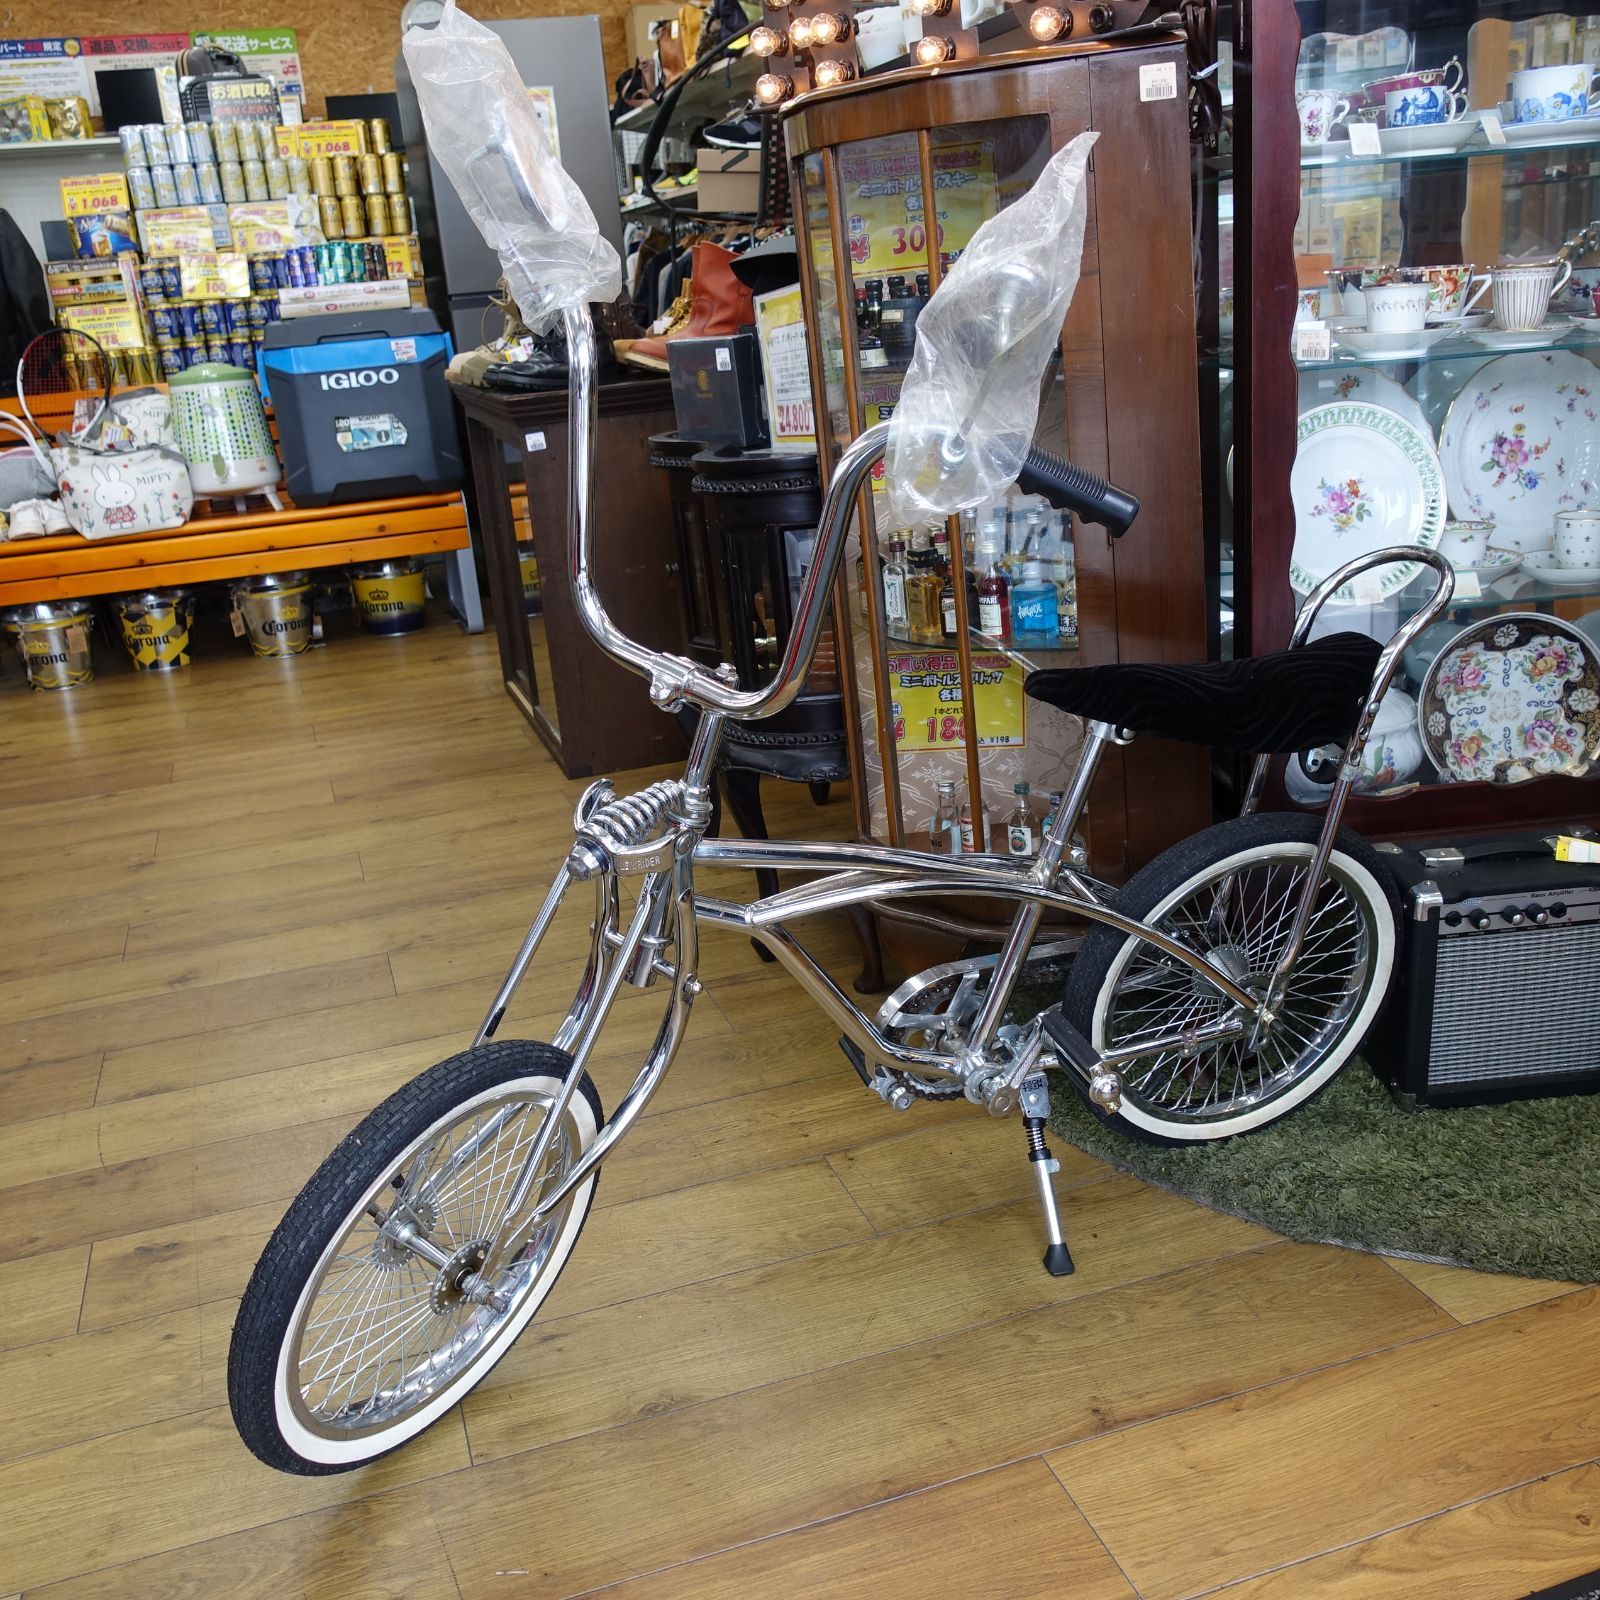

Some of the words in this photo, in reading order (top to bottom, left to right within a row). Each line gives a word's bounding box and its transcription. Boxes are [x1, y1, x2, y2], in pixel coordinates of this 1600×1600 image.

[320, 368, 399, 391] IGLOO
[363, 600, 405, 616] Corona
[262, 617, 304, 636] Coron
[124, 634, 170, 650] Corona
[29, 652, 67, 666] orona
